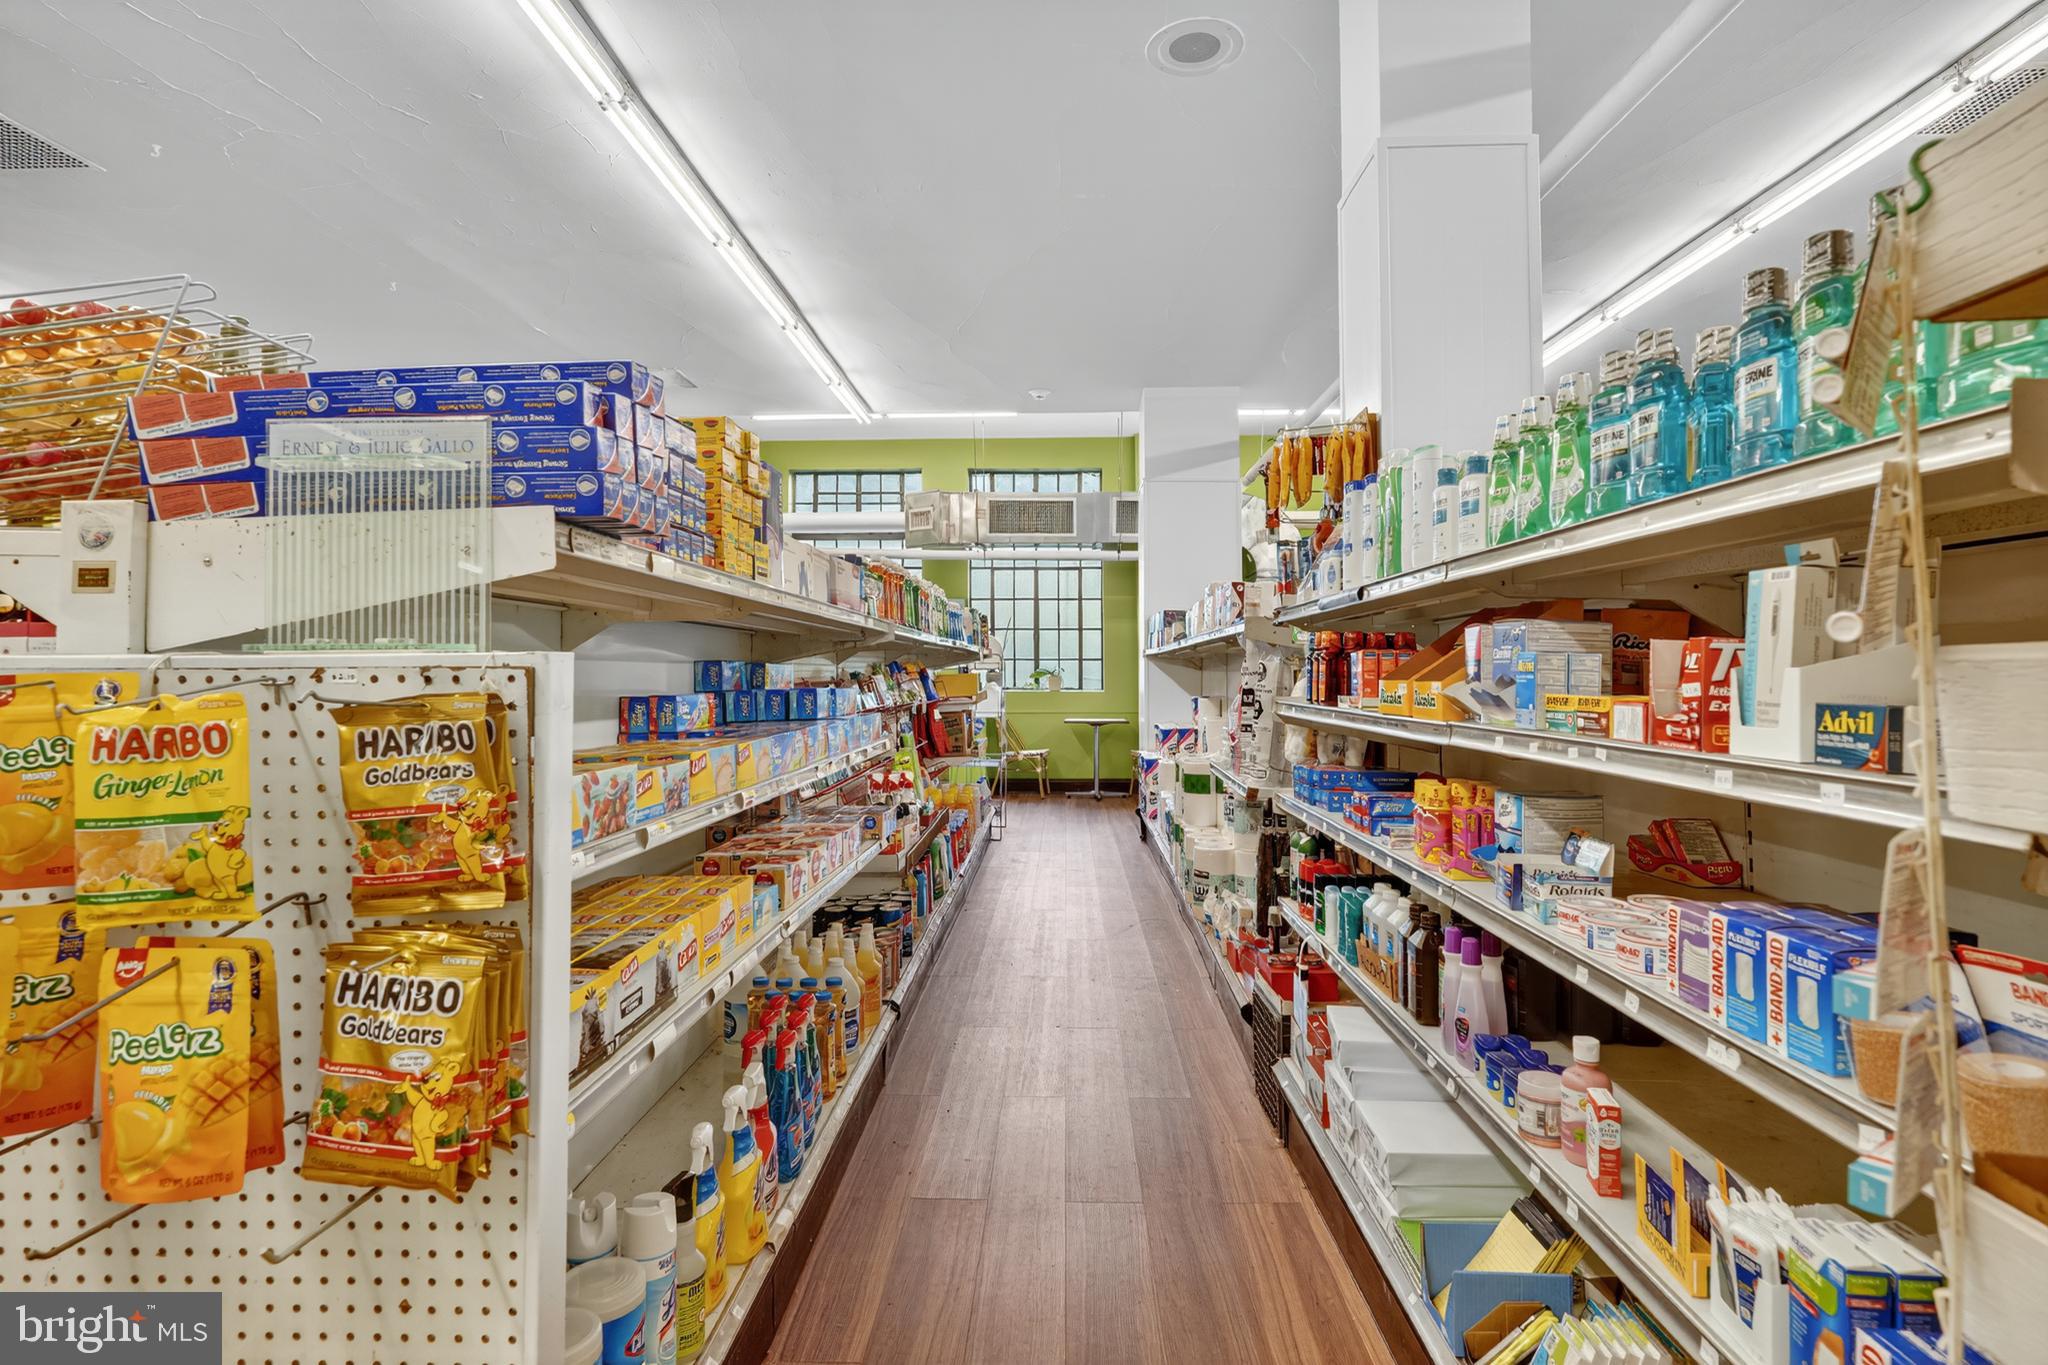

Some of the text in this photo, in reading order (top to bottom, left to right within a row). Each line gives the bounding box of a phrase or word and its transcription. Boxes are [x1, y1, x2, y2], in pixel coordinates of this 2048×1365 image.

[419, 438, 475, 455] GALLO
[1817, 709, 1875, 735] Advil
[91, 721, 231, 764] HARBO
[356, 721, 476, 762] HARIBO
[365, 762, 476, 787] Goldbears
[337, 972, 463, 1015] HARIBO
[108, 1022, 224, 1065] Peelerz
[340, 1015, 444, 1047] Goldbears
